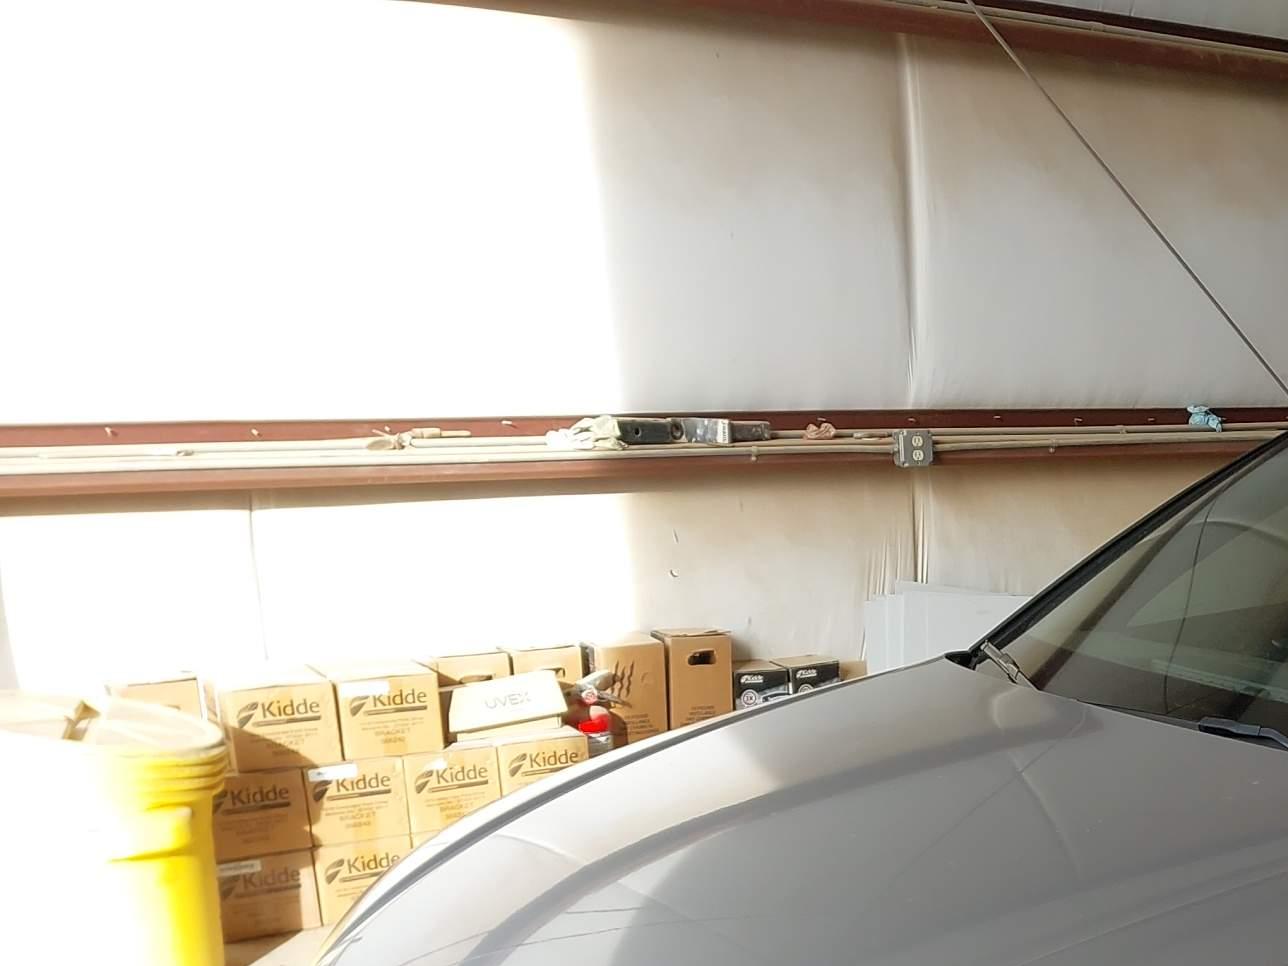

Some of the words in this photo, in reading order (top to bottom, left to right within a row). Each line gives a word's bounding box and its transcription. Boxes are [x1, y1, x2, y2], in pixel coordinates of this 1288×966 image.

[372, 688, 427, 707] Kidde
[261, 698, 320, 719] Kidde
[529, 749, 579, 768] Kidde
[336, 773, 392, 793] Kidde
[436, 764, 489, 785] Kidde
[231, 785, 289, 806] Kidde
[242, 866, 301, 890] Kidde
